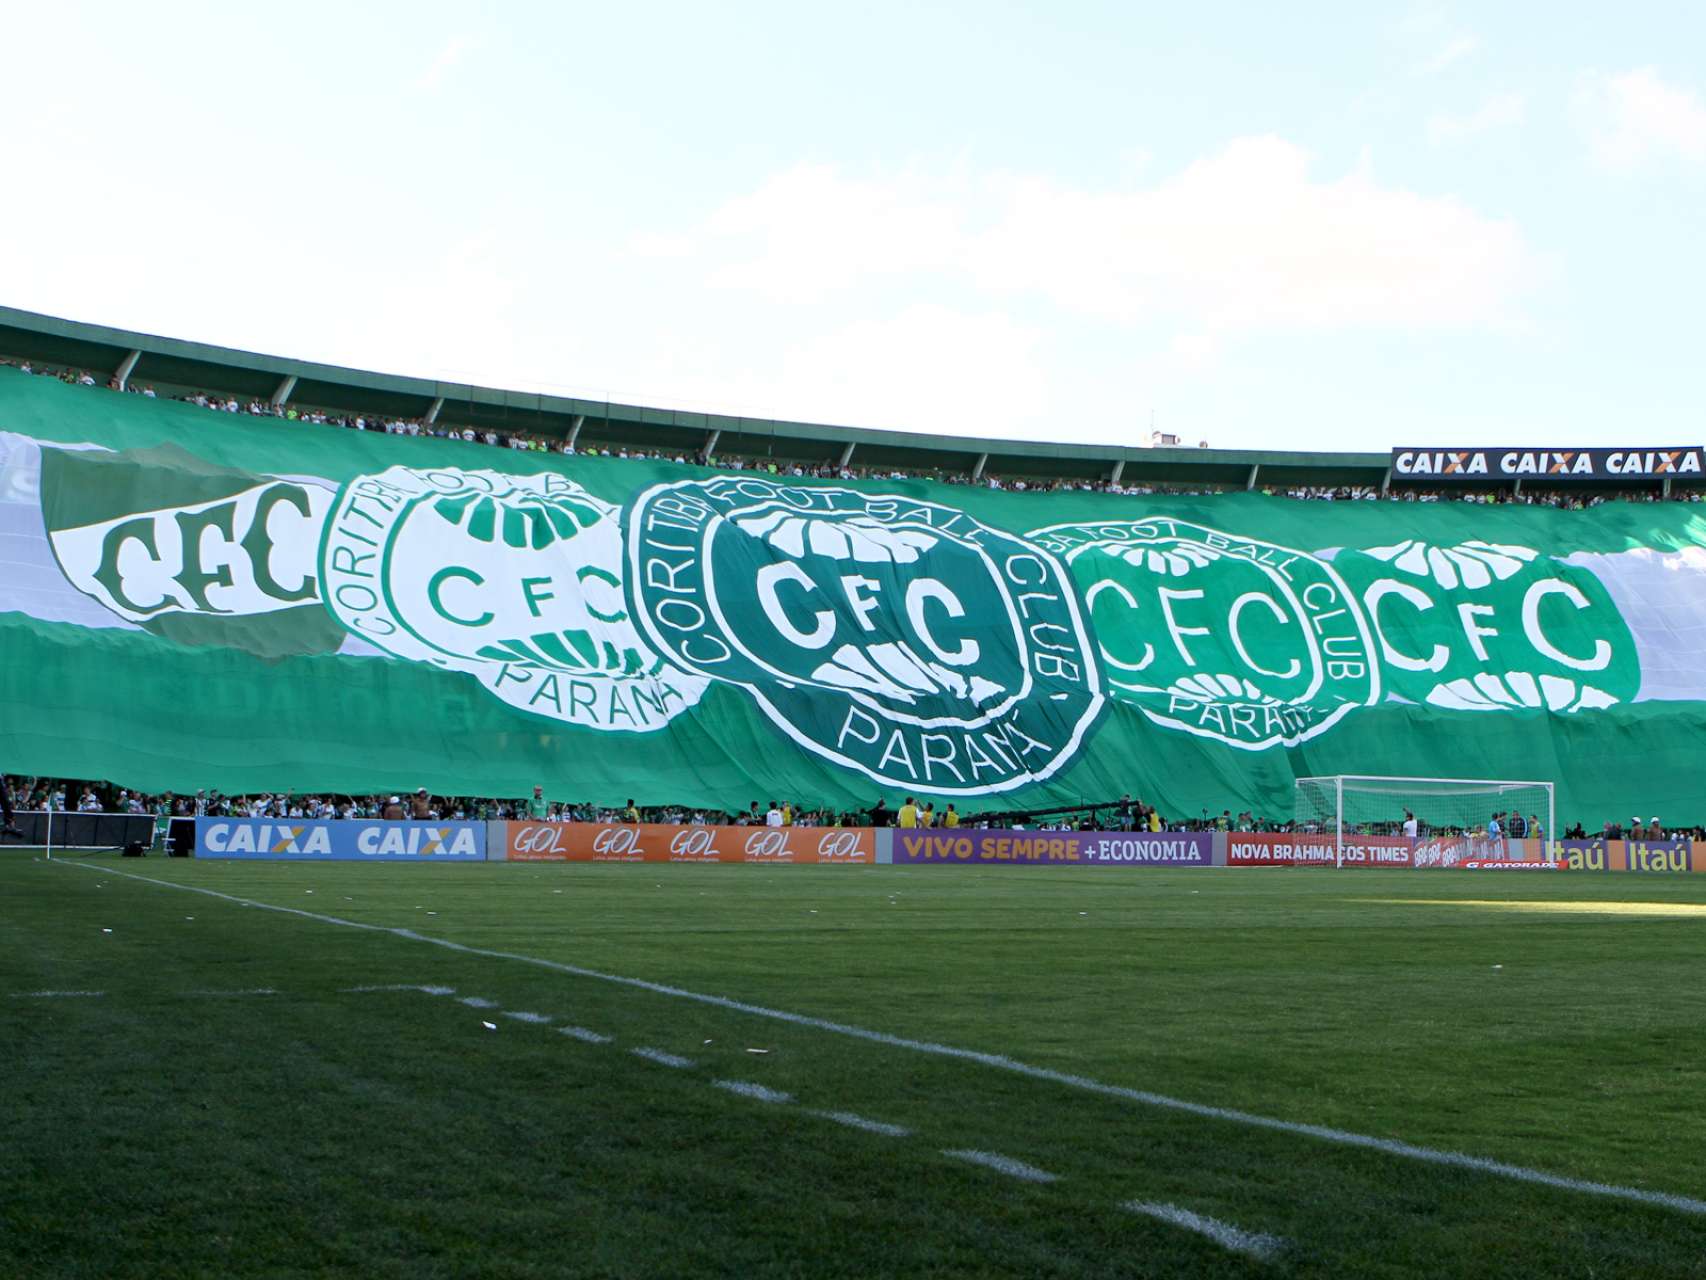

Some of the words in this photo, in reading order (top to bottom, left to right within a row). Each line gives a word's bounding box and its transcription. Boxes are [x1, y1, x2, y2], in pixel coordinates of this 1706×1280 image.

[1396, 452, 1488, 474] CAIXA
[1500, 452, 1593, 474] CAIXA
[1606, 451, 1701, 474] CAIXA
[92, 481, 319, 615] CFC
[756, 561, 980, 666] CFC
[1005, 553, 1081, 682] CLUB
[1363, 577, 1612, 673] CFC
[1085, 579, 1302, 680] CFC
[1303, 582, 1366, 681] CLUB
[204, 823, 333, 855] CAIXA
[357, 826, 477, 856] CAIXA
[514, 826, 567, 853] GOL
[592, 828, 645, 855] GOL
[670, 829, 721, 856] GOL
[745, 831, 794, 857] GOL
[817, 831, 867, 857] GOL
[903, 836, 974, 860] VIVO
[980, 838, 1080, 860] SEMPRE
[1231, 843, 1271, 860] NOVA
[1273, 844, 1335, 861] BRAHMA
[1367, 846, 1409, 862] TIMES
[1629, 842, 1687, 871] Itaú
